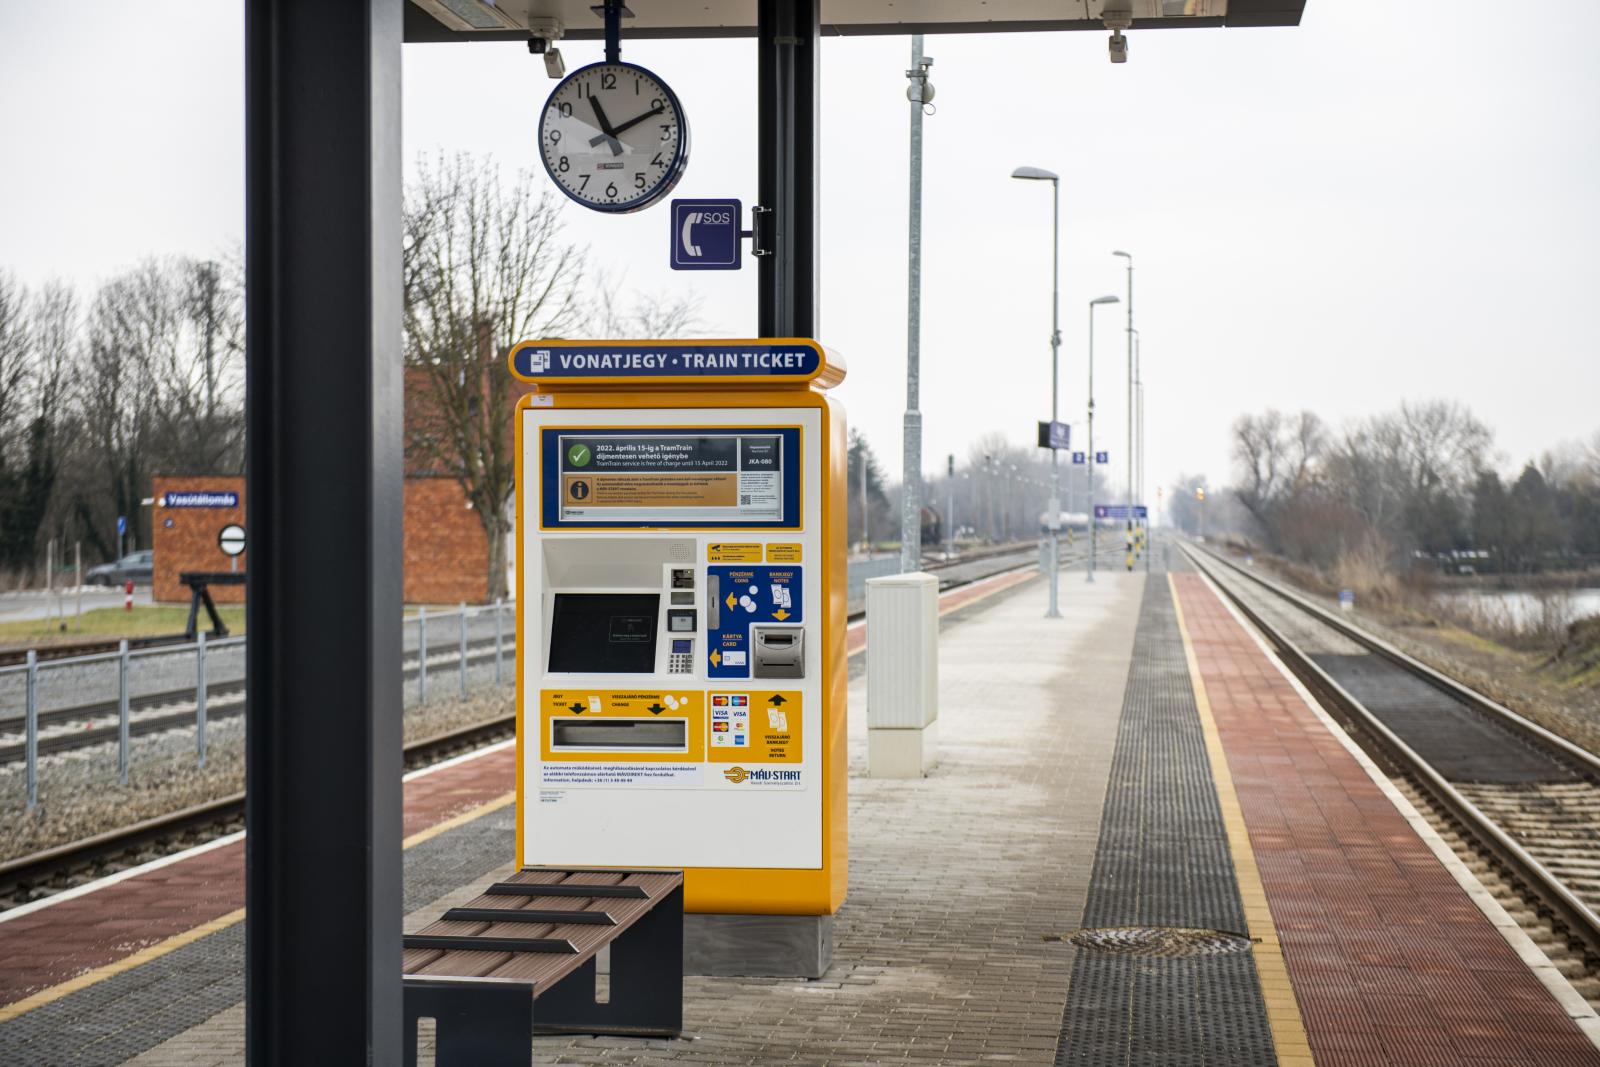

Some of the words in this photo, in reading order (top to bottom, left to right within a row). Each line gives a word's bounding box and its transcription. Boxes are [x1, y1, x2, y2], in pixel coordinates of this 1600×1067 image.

[601, 73, 616, 90] 12
[635, 79, 639, 96] 1
[577, 82, 591, 99] 11
[558, 102, 573, 118] 10
[549, 129, 562, 145] 9
[660, 125, 671, 141] 3
[558, 156, 570, 172] 8
[650, 152, 665, 168] 4
[578, 174, 591, 190] 7
[634, 173, 646, 189] 5
[605, 182, 618, 198] 6
[703, 212, 730, 223] SOS
[560, 353, 668, 369] VONATJEGY
[682, 353, 741, 368] TRAIN
[742, 352, 806, 368] TICKET
[596, 444, 615, 452] 2022.
[616, 444, 636, 453] április
[637, 444, 655, 454] 15-ig
[660, 444, 693, 452] TramTrain
[596, 452, 636, 461] díjmentesen
[638, 452, 661, 460] vehető
[661, 452, 689, 461] igénybe
[662, 460, 681, 468] charge
[168, 493, 236, 506] Vasútállomás
